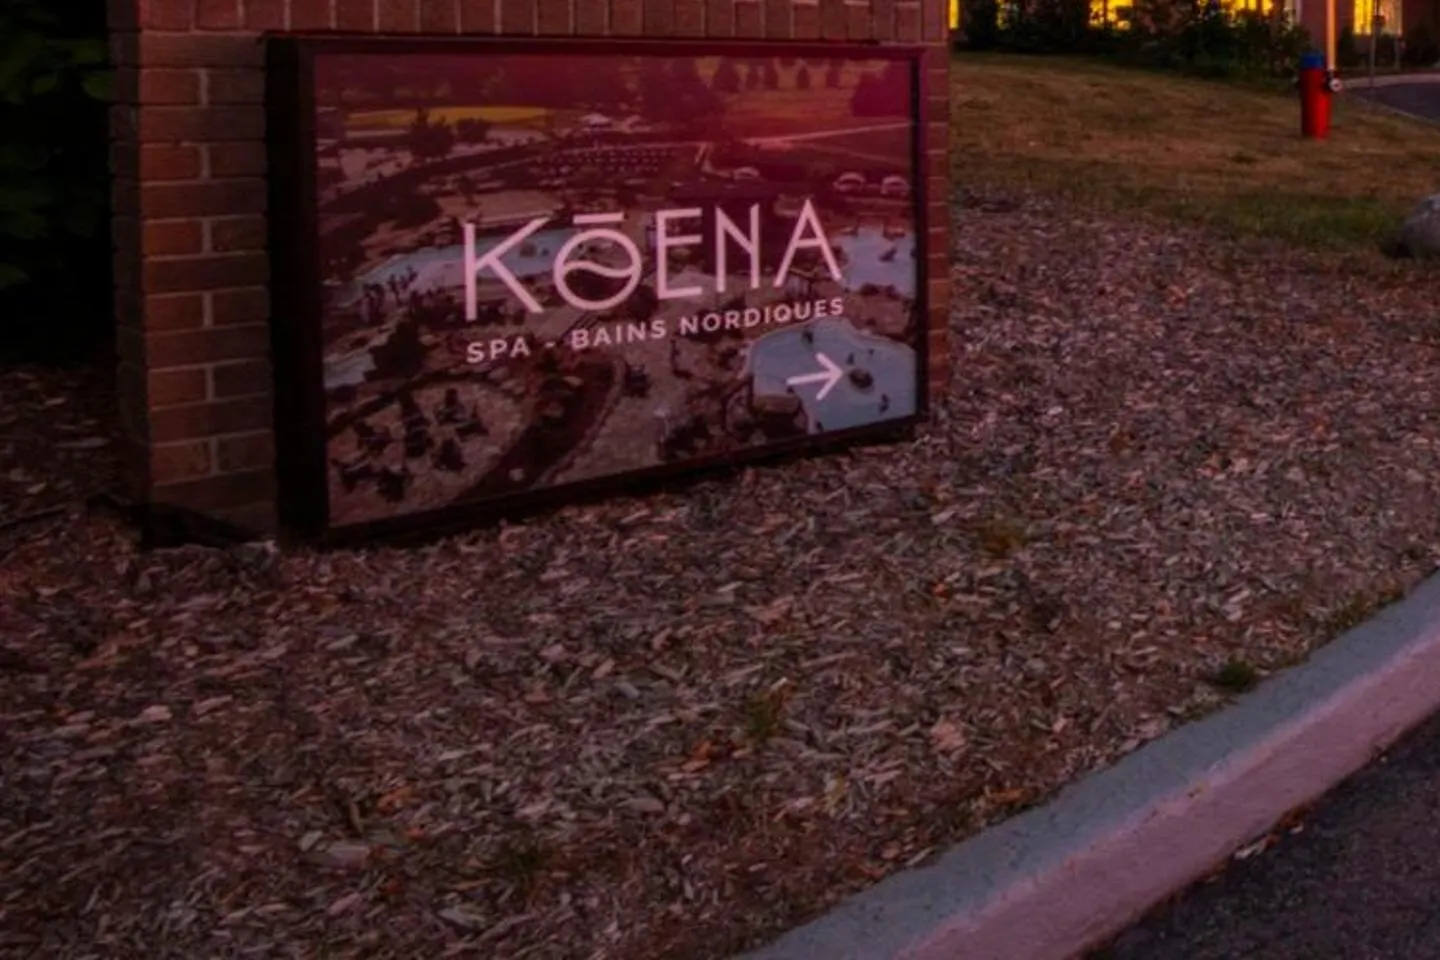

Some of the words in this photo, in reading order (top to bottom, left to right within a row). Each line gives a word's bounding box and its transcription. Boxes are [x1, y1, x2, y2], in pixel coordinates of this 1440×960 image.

[466, 338, 531, 365] SPA
[572, 319, 667, 351] BAINS
[680, 297, 845, 337] NORDIQUES
